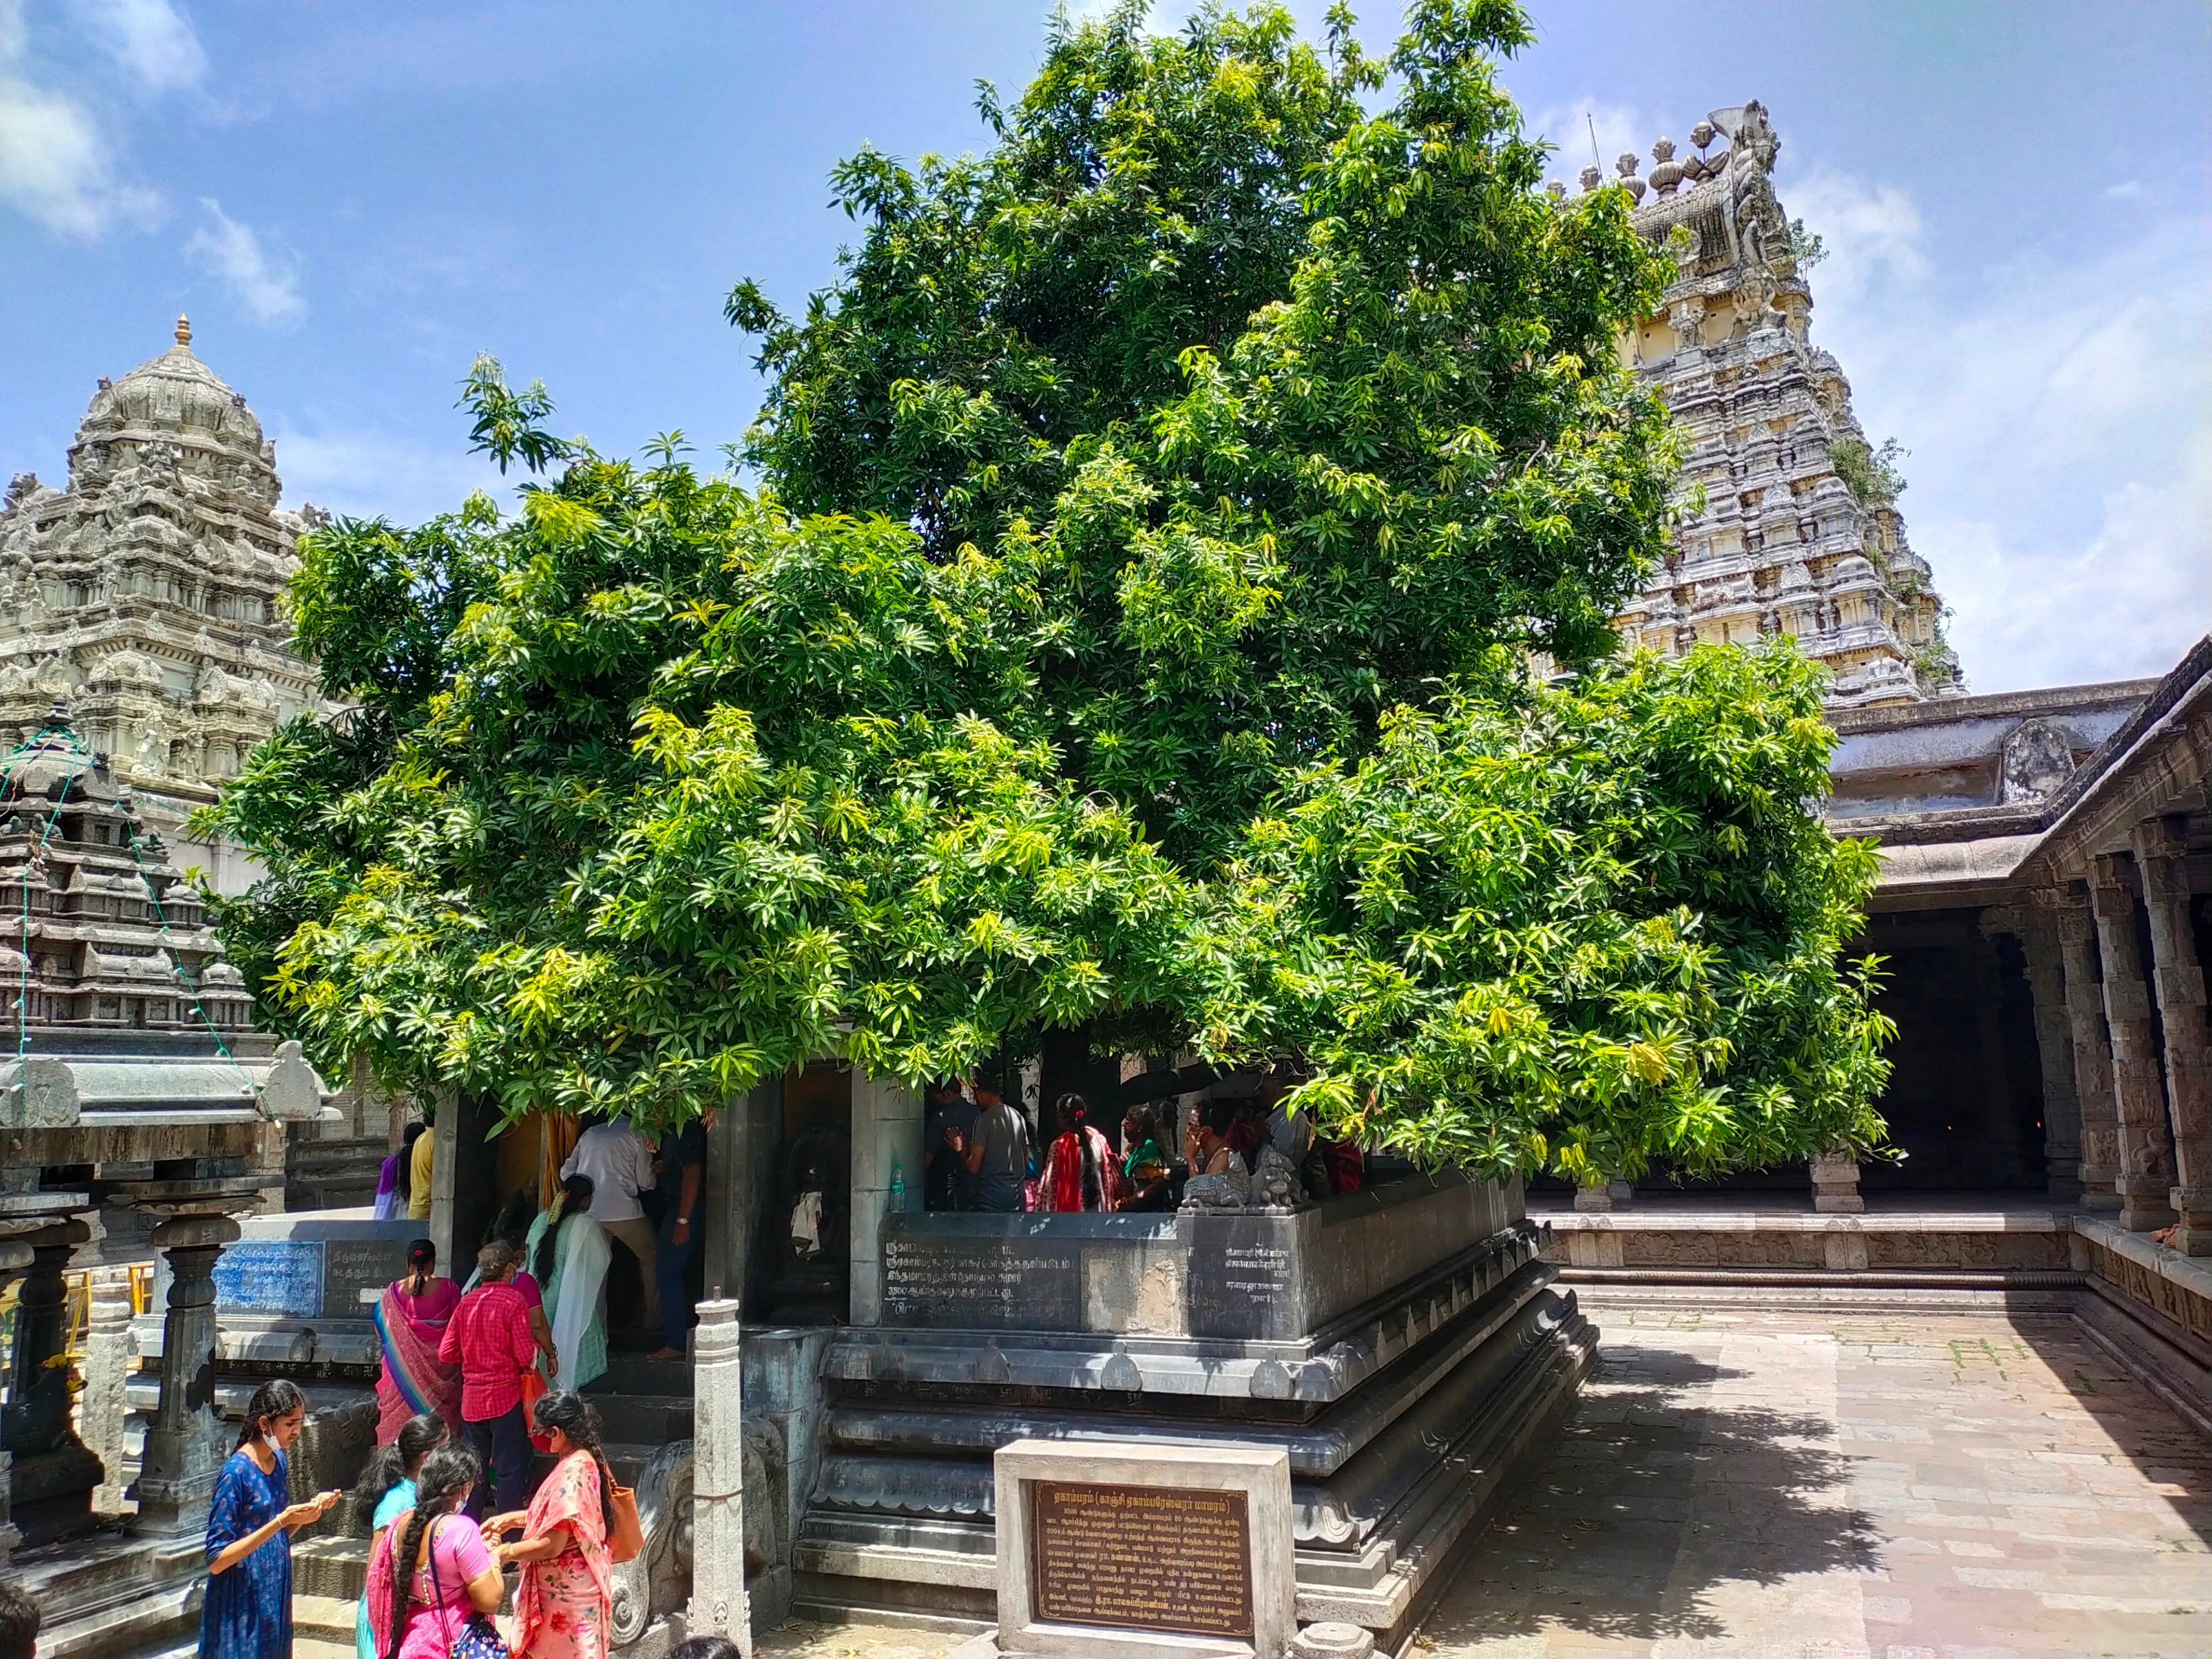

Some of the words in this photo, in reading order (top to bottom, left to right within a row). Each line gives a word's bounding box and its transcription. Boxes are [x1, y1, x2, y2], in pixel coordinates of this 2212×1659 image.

[888, 1287, 907, 1296] 3500
[1054, 1488, 1094, 1506] ஏகாம்பரம்
[1095, 1491, 1125, 1507] (காஞ்சி
[1126, 1493, 1193, 1512] ஏகாம்பரேஸ்வரர்
[1194, 1497, 1229, 1514] மாமரம்)
[1079, 1508, 1116, 1518] ஆண்டுகளுக்கு
[1119, 1510, 1139, 1519] முற்பட்ட
[1142, 1512, 1172, 1521] இம்மாமரம்
[1184, 1515, 1222, 1525] ஆண்டுகளுக்கு
[1224, 1517, 1239, 1527] முன்பு
[1060, 1517, 1088, 1527] ஆரம்பித்து
[1091, 1520, 1116, 1529] முழுவதும்
[1153, 1523, 1180, 1533] (இறக்கும்)
[1066, 1528, 1084, 1537] ஆண்டு
[1157, 1544, 1176, 1555] மற்றும்
